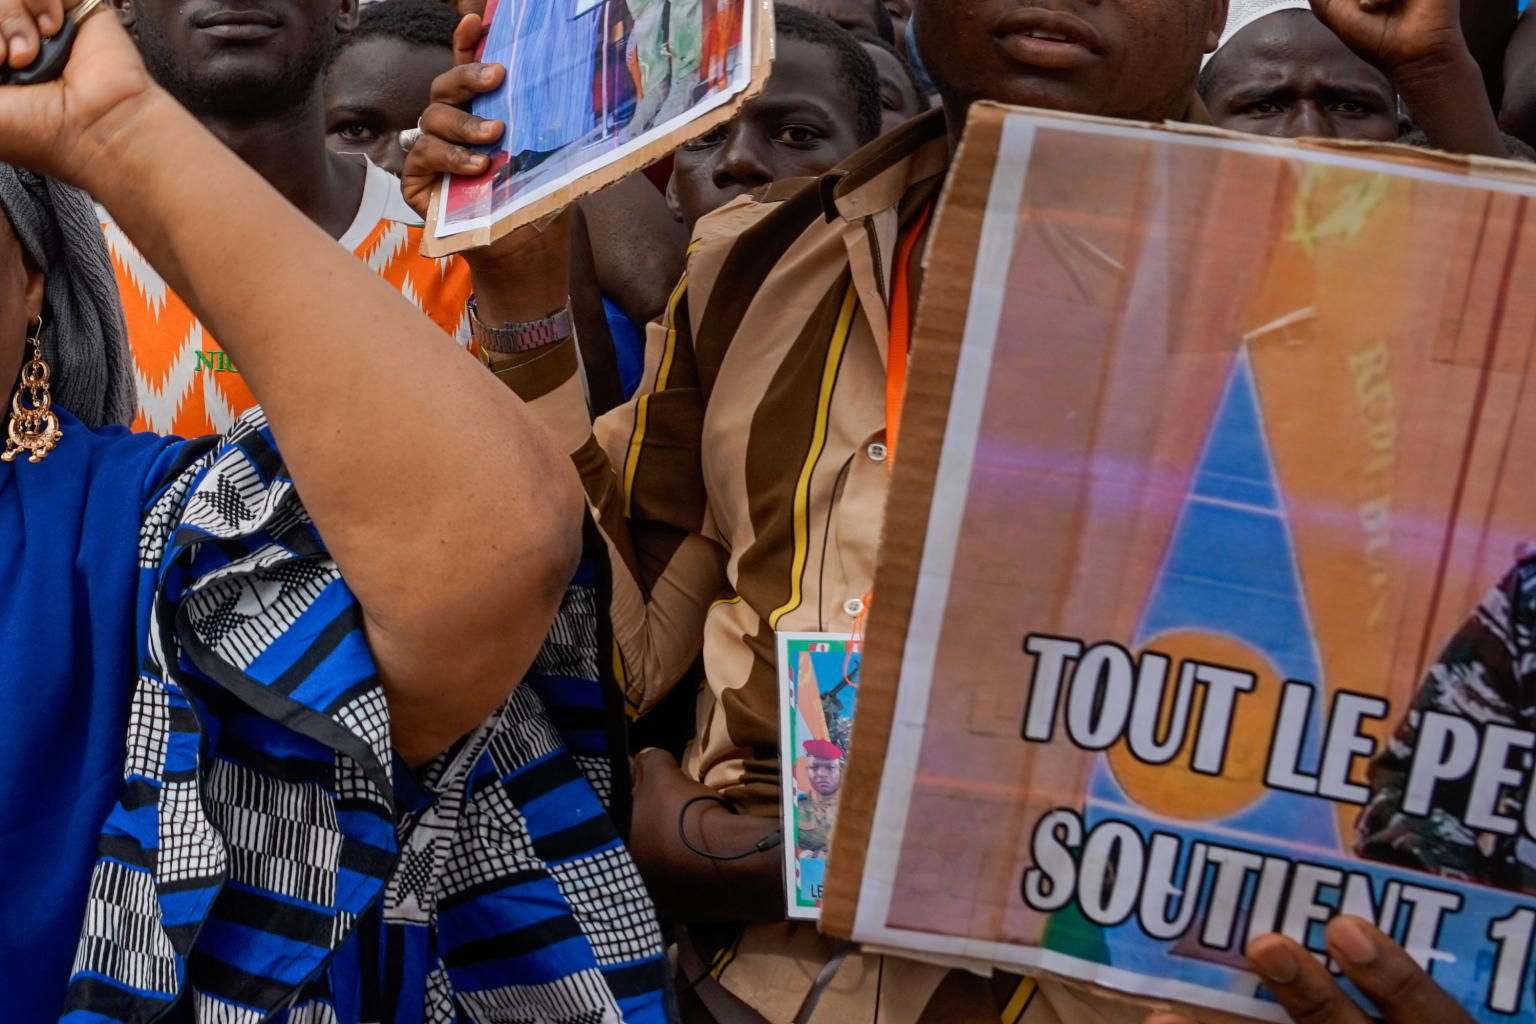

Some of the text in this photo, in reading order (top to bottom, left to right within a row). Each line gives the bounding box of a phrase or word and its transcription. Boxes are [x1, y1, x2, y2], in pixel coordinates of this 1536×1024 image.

[1022, 633, 1536, 844] TOUT LE PE
